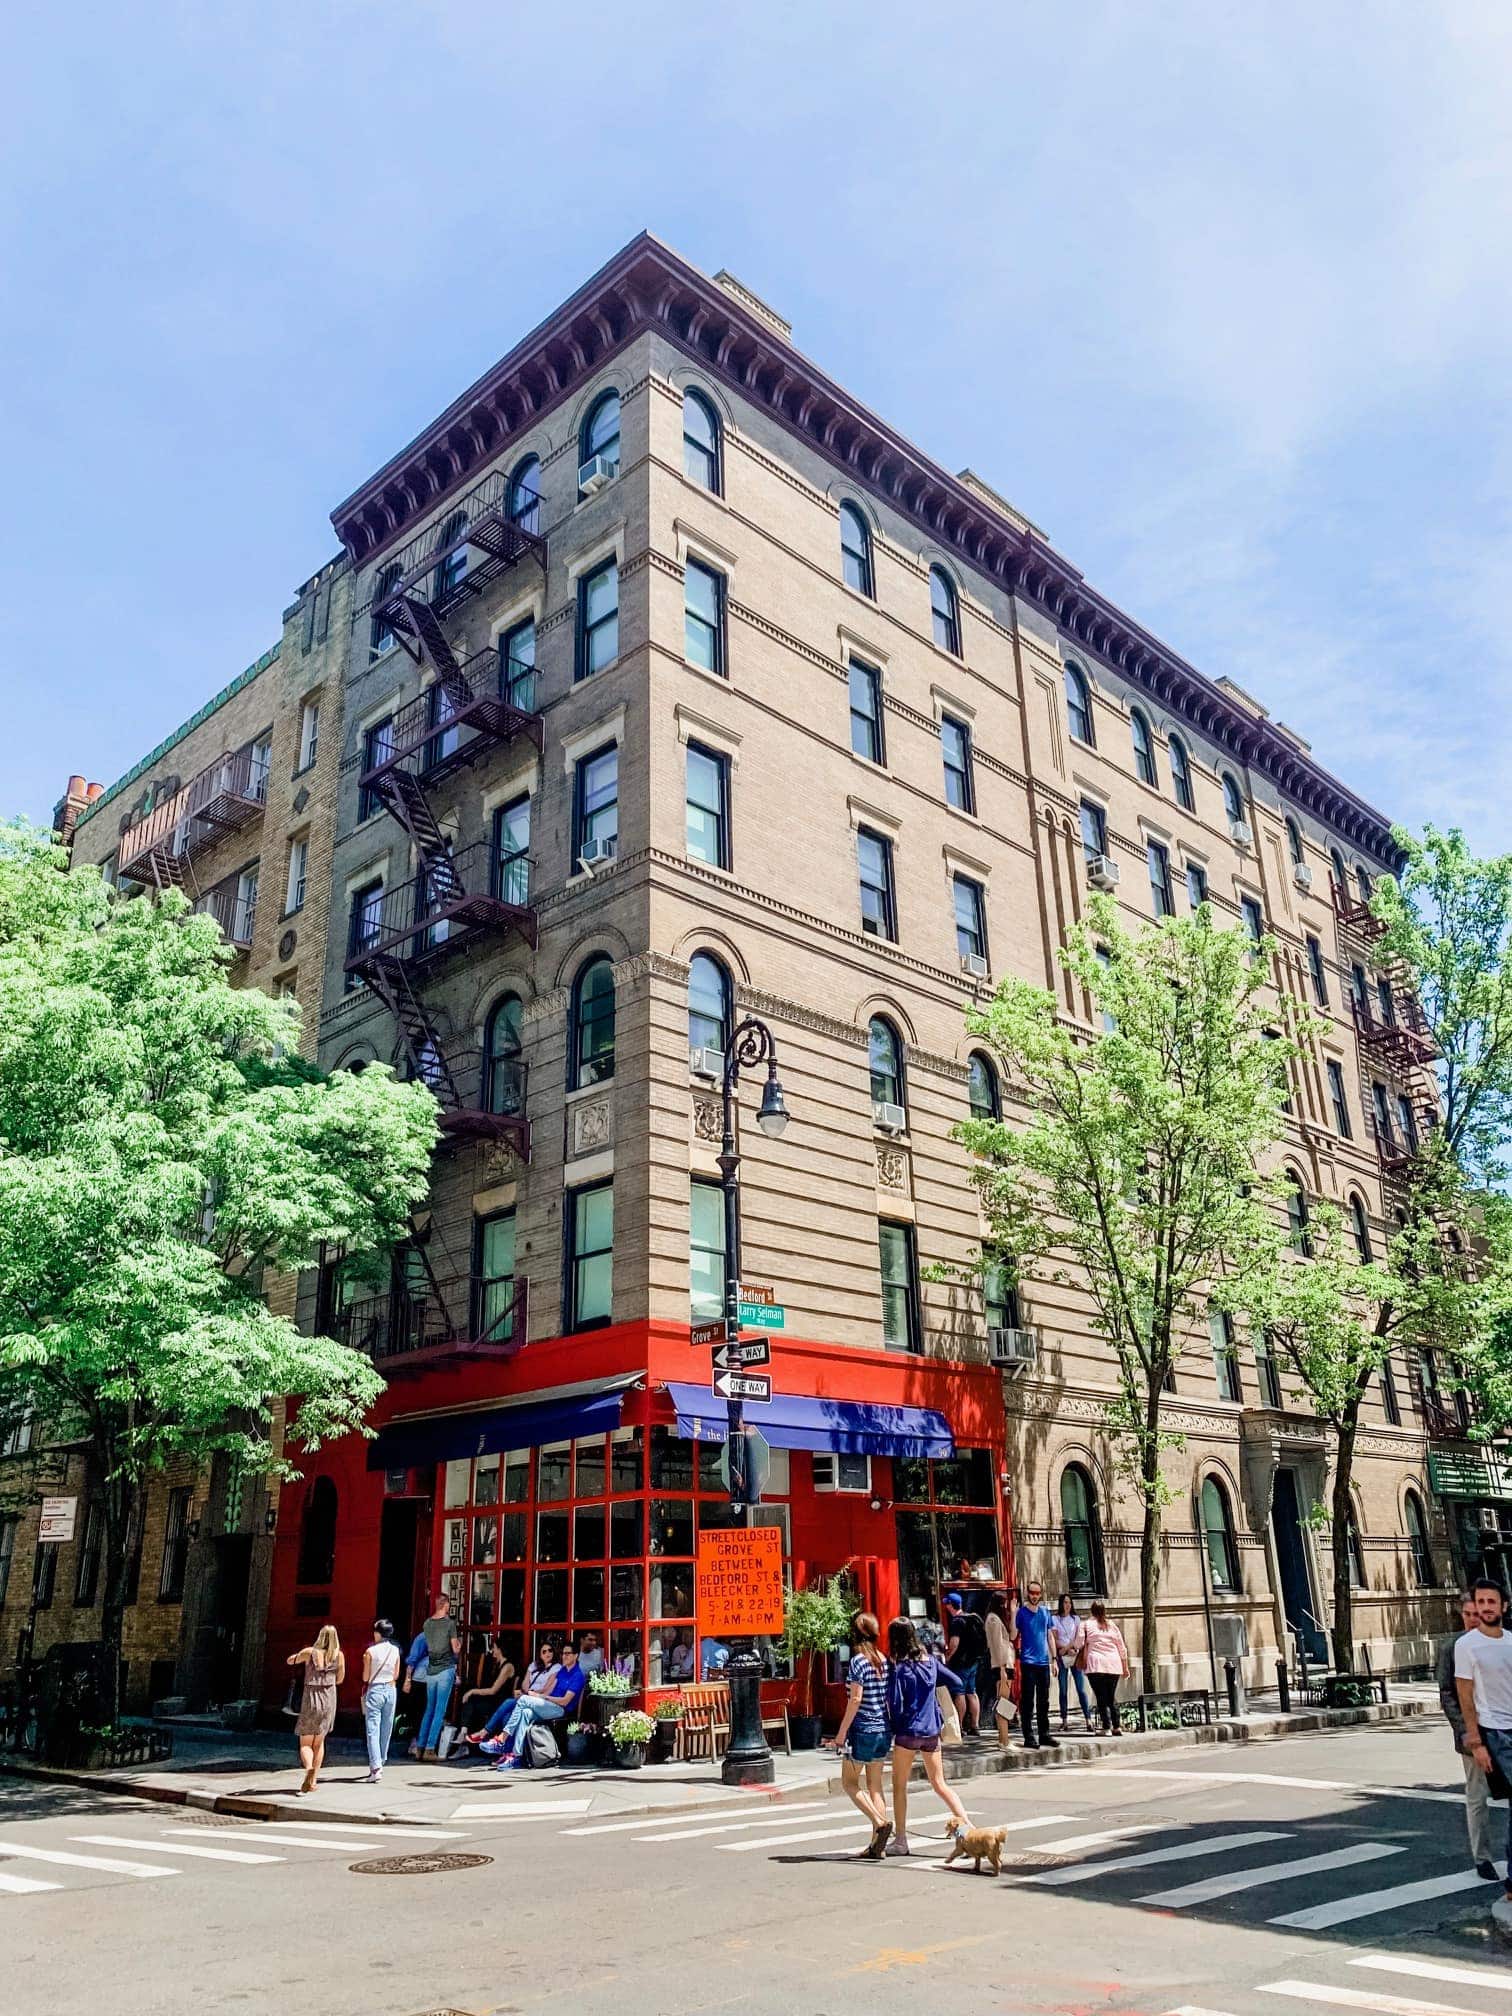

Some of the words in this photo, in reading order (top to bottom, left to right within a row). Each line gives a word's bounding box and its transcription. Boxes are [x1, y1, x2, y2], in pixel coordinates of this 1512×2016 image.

[740, 1304, 756, 1319] Larry
[757, 1306, 782, 1320] Selman
[691, 1330, 711, 1345] Grove
[745, 1346, 762, 1360] WAY
[730, 1380, 746, 1392] ONE
[748, 1382, 765, 1393] WAY
[707, 1428, 720, 1440] the
[718, 1543, 753, 1556] GROVE
[766, 1542, 779, 1553] ST
[712, 1557, 763, 1572] BETWEEN
[700, 1573, 748, 1586] BEDFORD
[757, 1571, 768, 1582] ST
[700, 1585, 759, 1598] BLEECKER
[766, 1583, 780, 1595] ST
